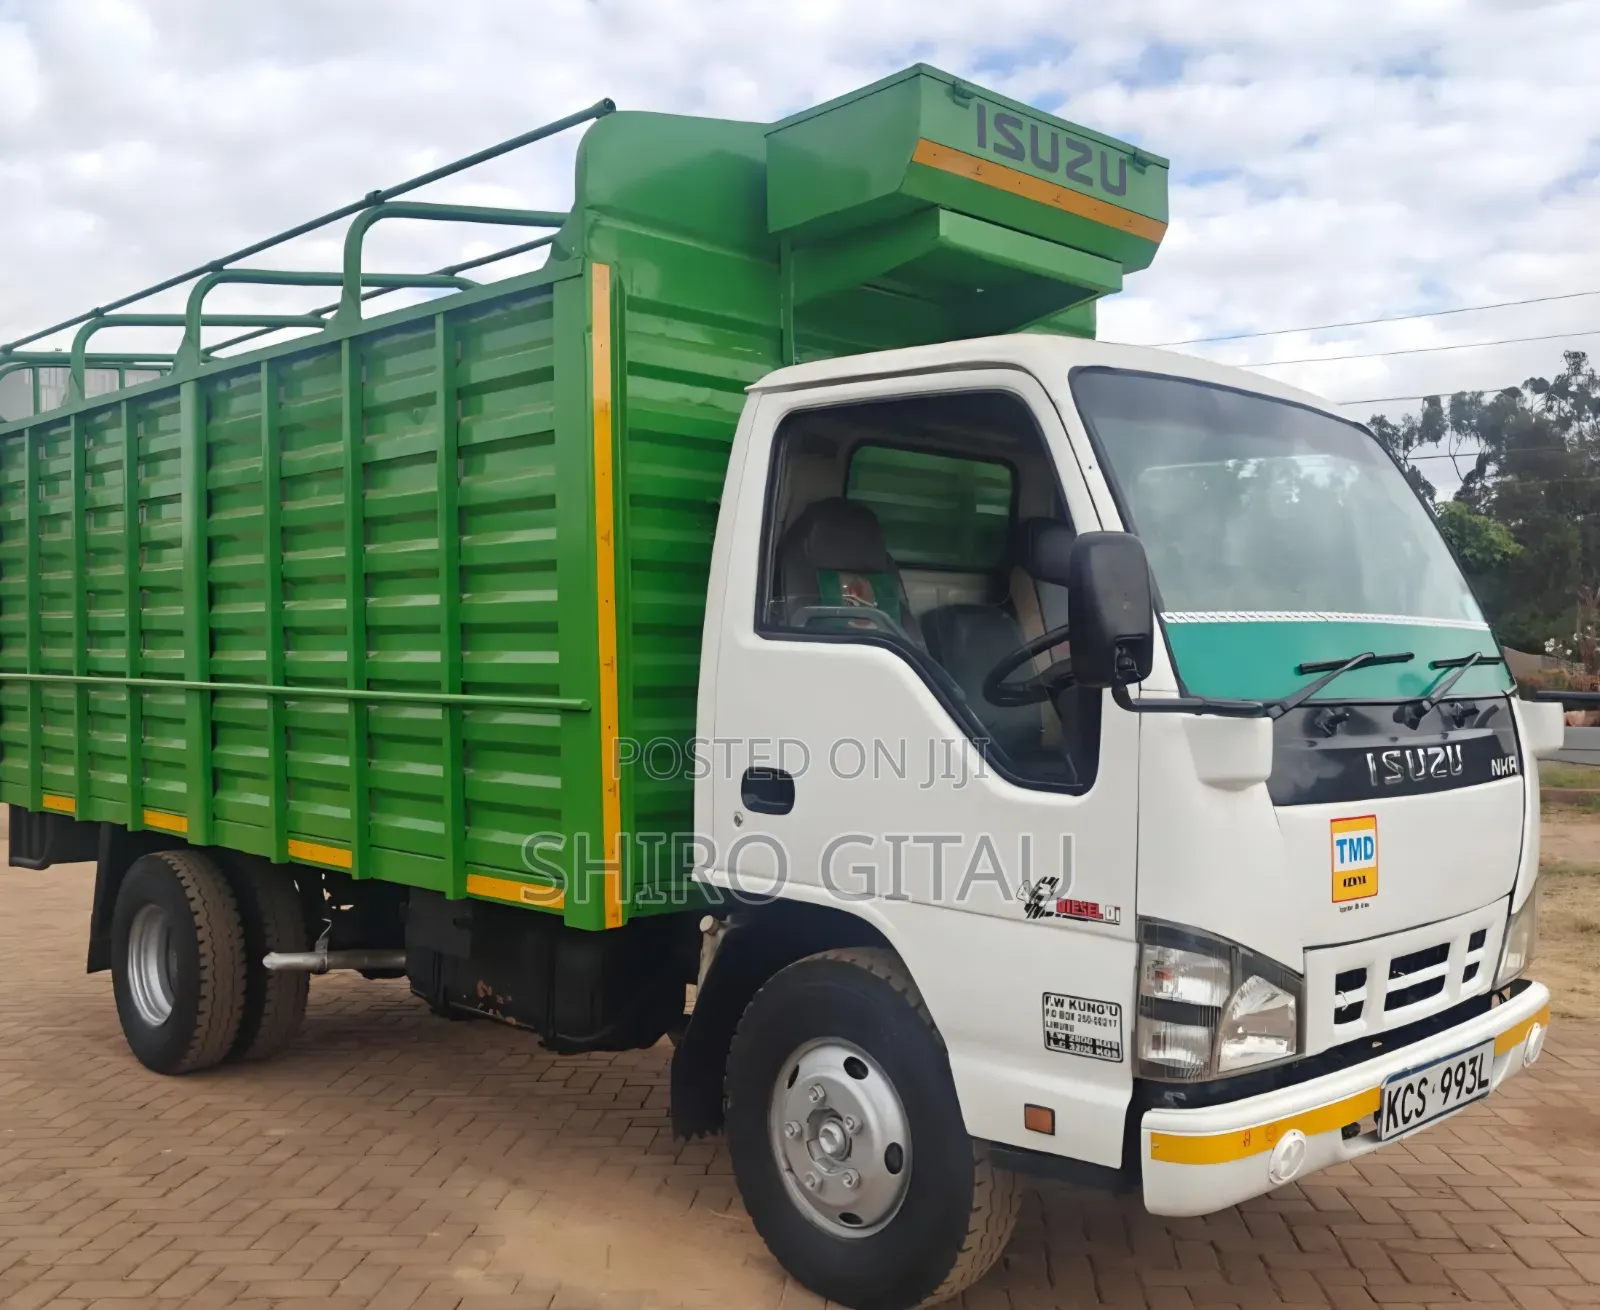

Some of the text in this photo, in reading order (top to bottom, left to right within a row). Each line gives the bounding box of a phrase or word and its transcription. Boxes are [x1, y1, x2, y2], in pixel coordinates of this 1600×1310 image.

[976, 103, 1127, 197] ISUZU
[1366, 745, 1464, 787] ISUZU
[1335, 836, 1375, 864] TMD
[1056, 897, 1104, 920] DIESEL
[1385, 1052, 1489, 1132] KCS 993L
